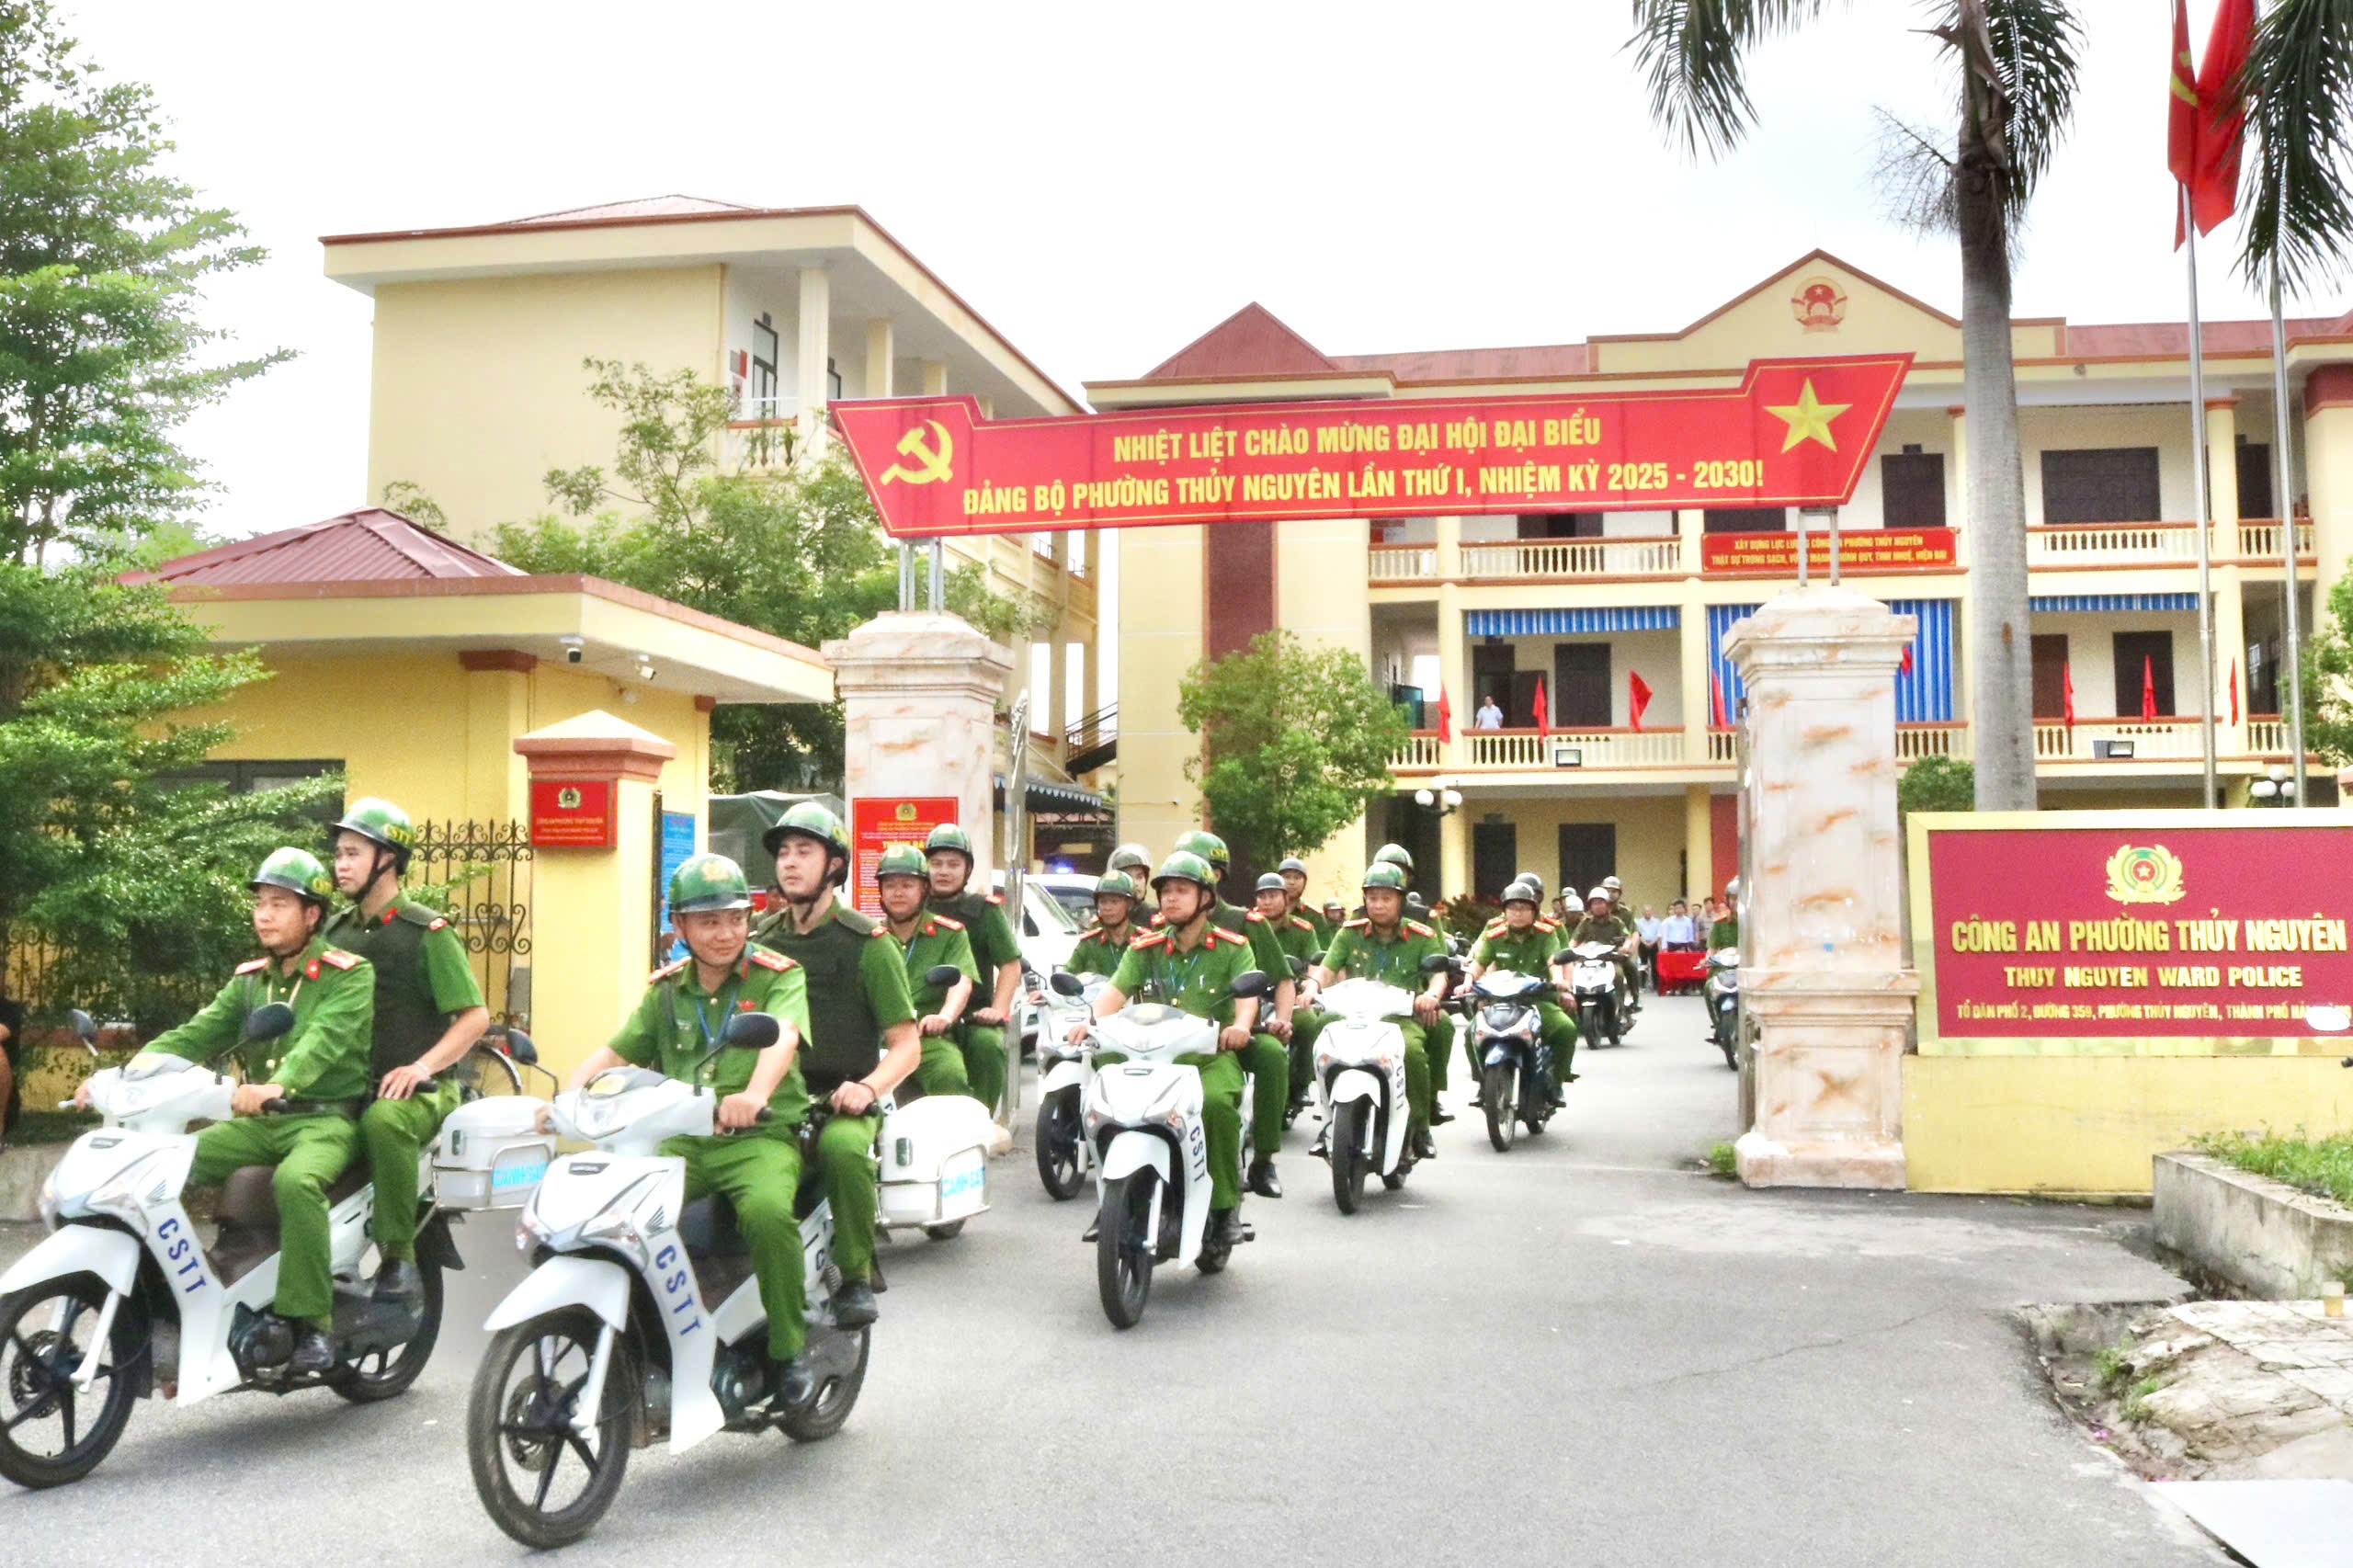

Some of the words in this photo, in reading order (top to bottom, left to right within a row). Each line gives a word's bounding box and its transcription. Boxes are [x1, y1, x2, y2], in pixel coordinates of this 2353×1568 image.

[1114, 428, 1183, 465] NHIỆT
[1189, 426, 1237, 463] LIỆT
[1245, 423, 1309, 456] CHÀO
[1317, 421, 1390, 453] MỪNG
[1397, 423, 1438, 456] ĐẠI
[1446, 415, 1487, 454] HỘI
[1495, 419, 1536, 453] ĐẠI
[1543, 407, 1601, 446] BIỂU
[963, 480, 1027, 515] ĐẢNG
[1034, 479, 1065, 516] BỘ
[1073, 474, 1169, 509] PHƯỜNG
[1176, 468, 1235, 504] THỦY
[1243, 467, 1340, 501] NGUYÊN
[1347, 461, 1395, 498] LẦN
[1402, 462, 1451, 496] THỨ
[1457, 468, 1472, 498] I,
[1479, 460, 1561, 499] NHIỆM
[1568, 459, 1599, 492] KỲ
[1608, 462, 1668, 491] 2025
[1693, 460, 1764, 488] 2030!
[1951, 914, 2018, 952] CÔNG
[2025, 921, 2061, 952] AN
[2069, 912, 2170, 952] PHƯỜNG
[2175, 908, 2238, 952] THỦY
[2245, 913, 2347, 952] NGUYÊN
[2004, 967, 2055, 987] THUY
[2064, 967, 2148, 987] NGUYEN
[2157, 966, 2221, 987] WARD
[2228, 966, 2302, 987] POLICE
[1997, 1000, 2019, 1019] PHỐ
[1190, 1125, 1205, 1182] CSTT
[158, 1218, 207, 1293] CSTT
[655, 1244, 700, 1335] CSTT
